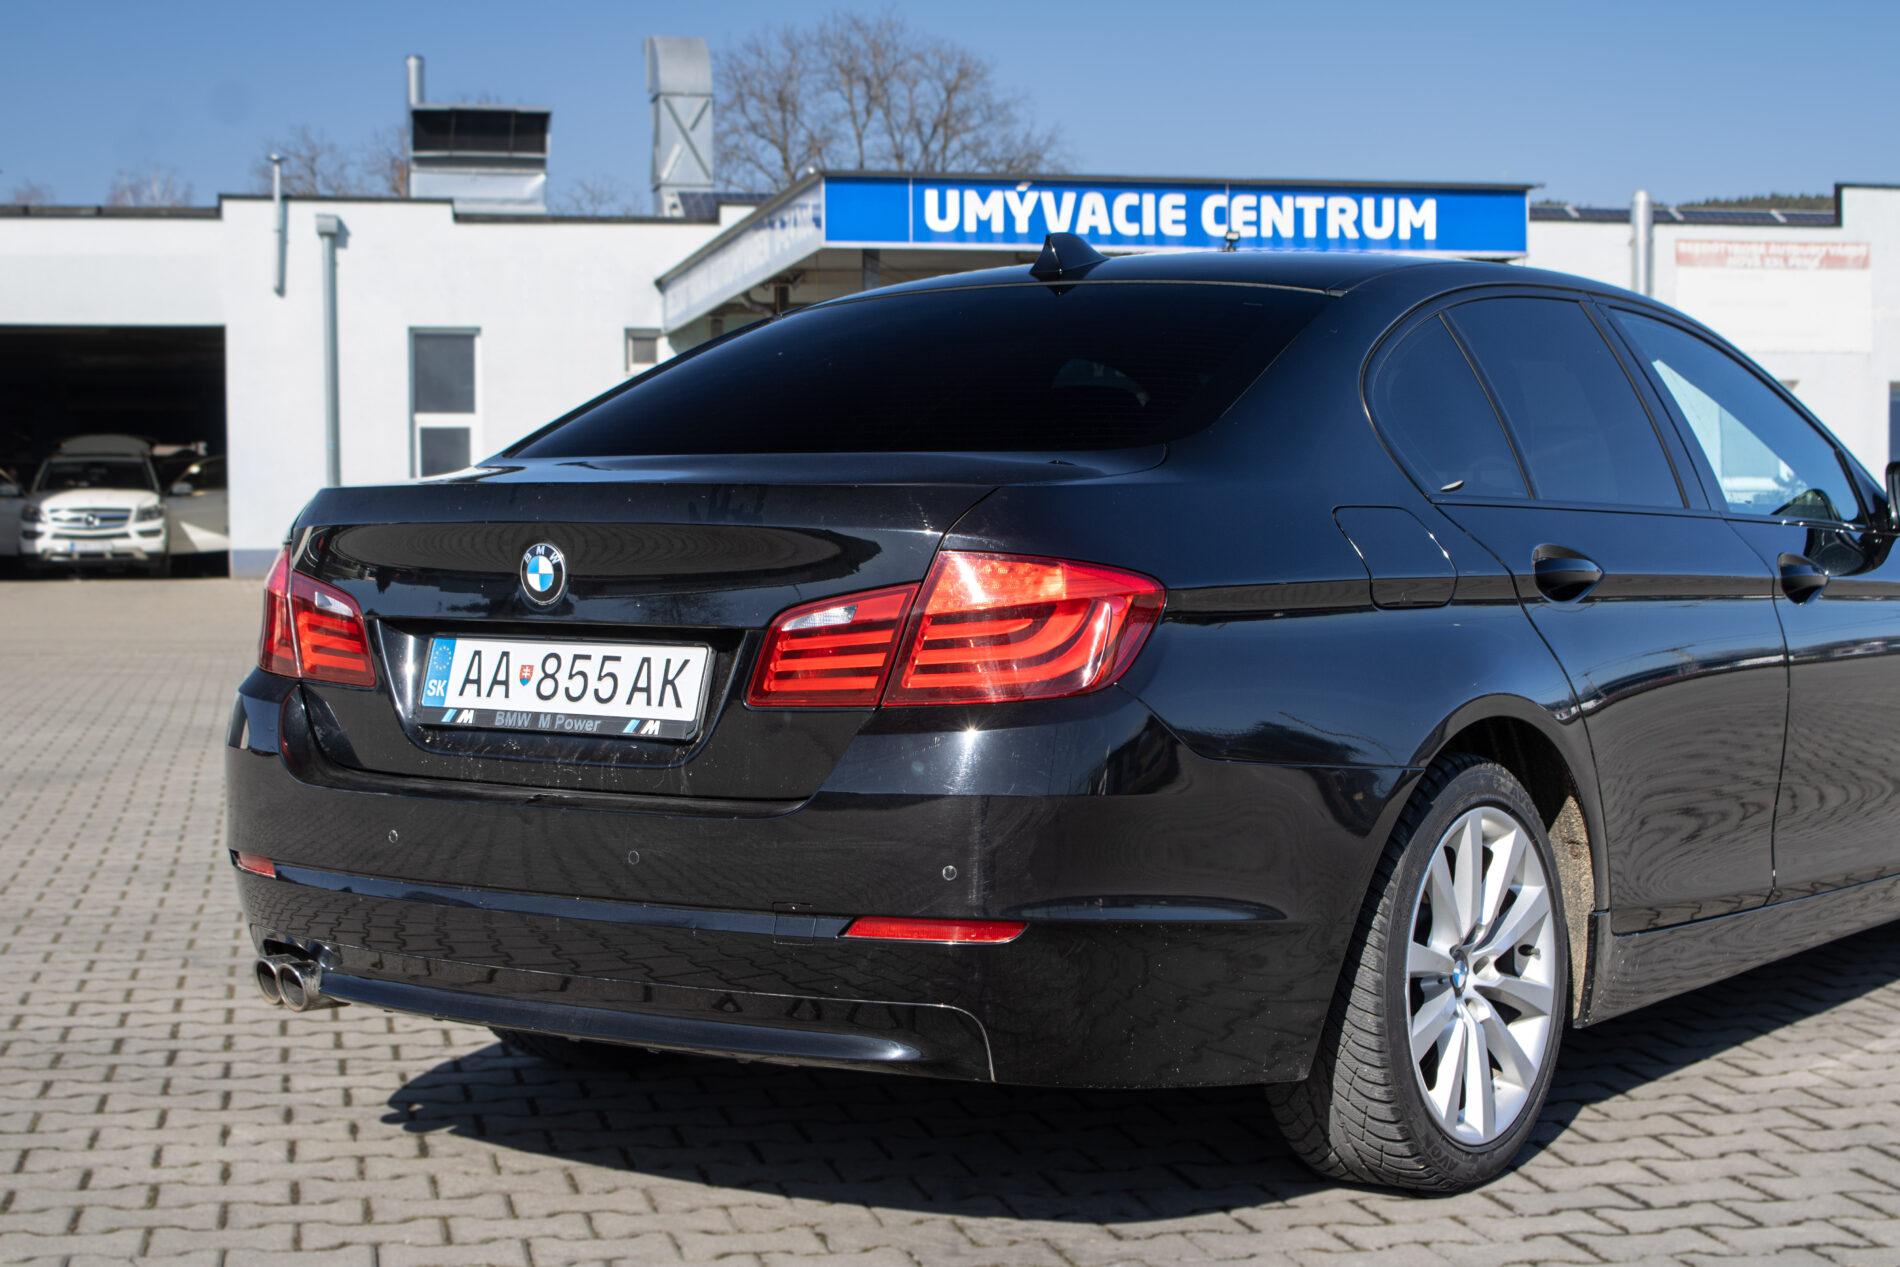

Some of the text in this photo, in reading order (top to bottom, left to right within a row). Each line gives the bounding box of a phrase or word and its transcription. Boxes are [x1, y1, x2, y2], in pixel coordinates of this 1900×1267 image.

[924, 182, 1437, 240] UMÝVACIE CENTRUM
[524, 545, 560, 565] BMW
[458, 650, 511, 698] AA
[426, 679, 447, 697] SK
[495, 711, 601, 733] BMW M Power
